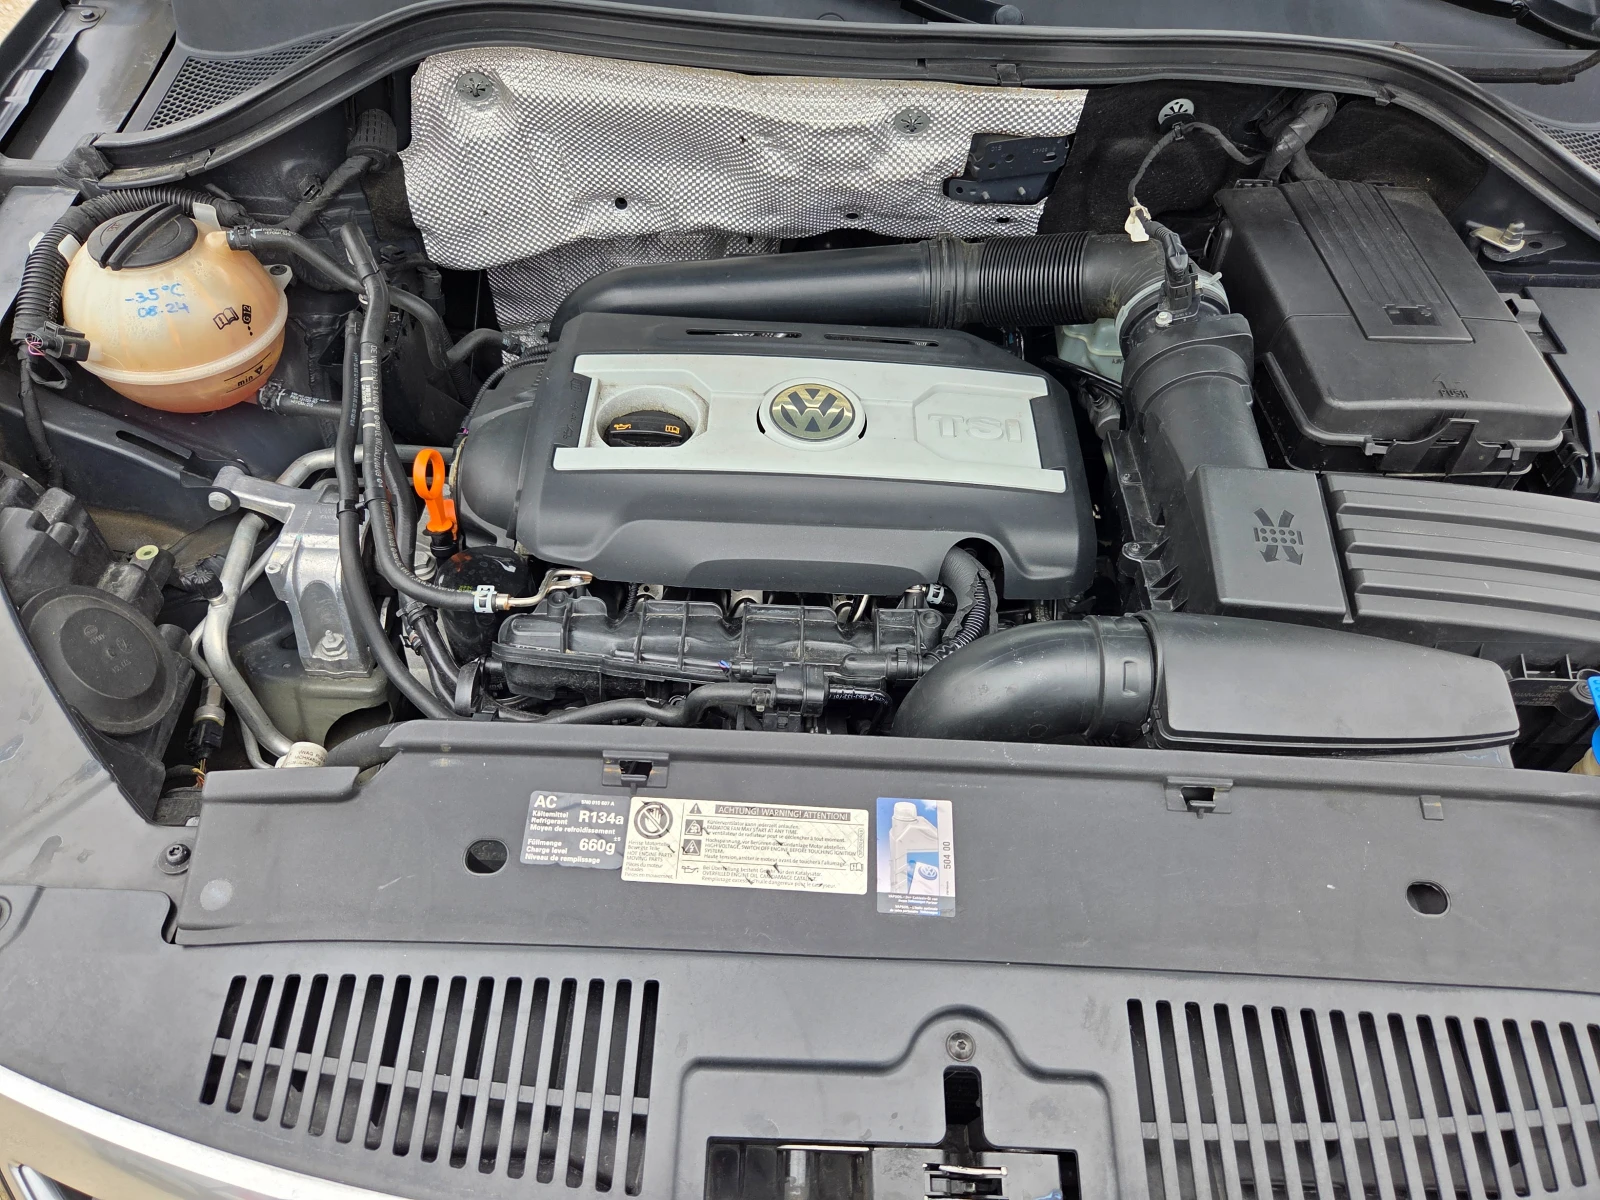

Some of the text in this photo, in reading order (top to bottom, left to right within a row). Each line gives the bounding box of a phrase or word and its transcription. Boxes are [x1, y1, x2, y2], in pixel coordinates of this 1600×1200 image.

[137, 302, 190, 318] 08.24
[242, 305, 251, 323] G12
[237, 376, 254, 387] min
[1438, 389, 1468, 398] PUSH
[770, 383, 856, 442] VW
[928, 413, 1022, 442] TSI
[534, 795, 558, 808] AC
[579, 810, 624, 825] R134a
[718, 806, 848, 820] ACHTUNG! WARNING! ATTENTION!
[528, 839, 562, 847] Füllmenge
[579, 838, 616, 856] 660g
[560, 856, 600, 864] remplissage
[943, 841, 951, 870] 504 00
